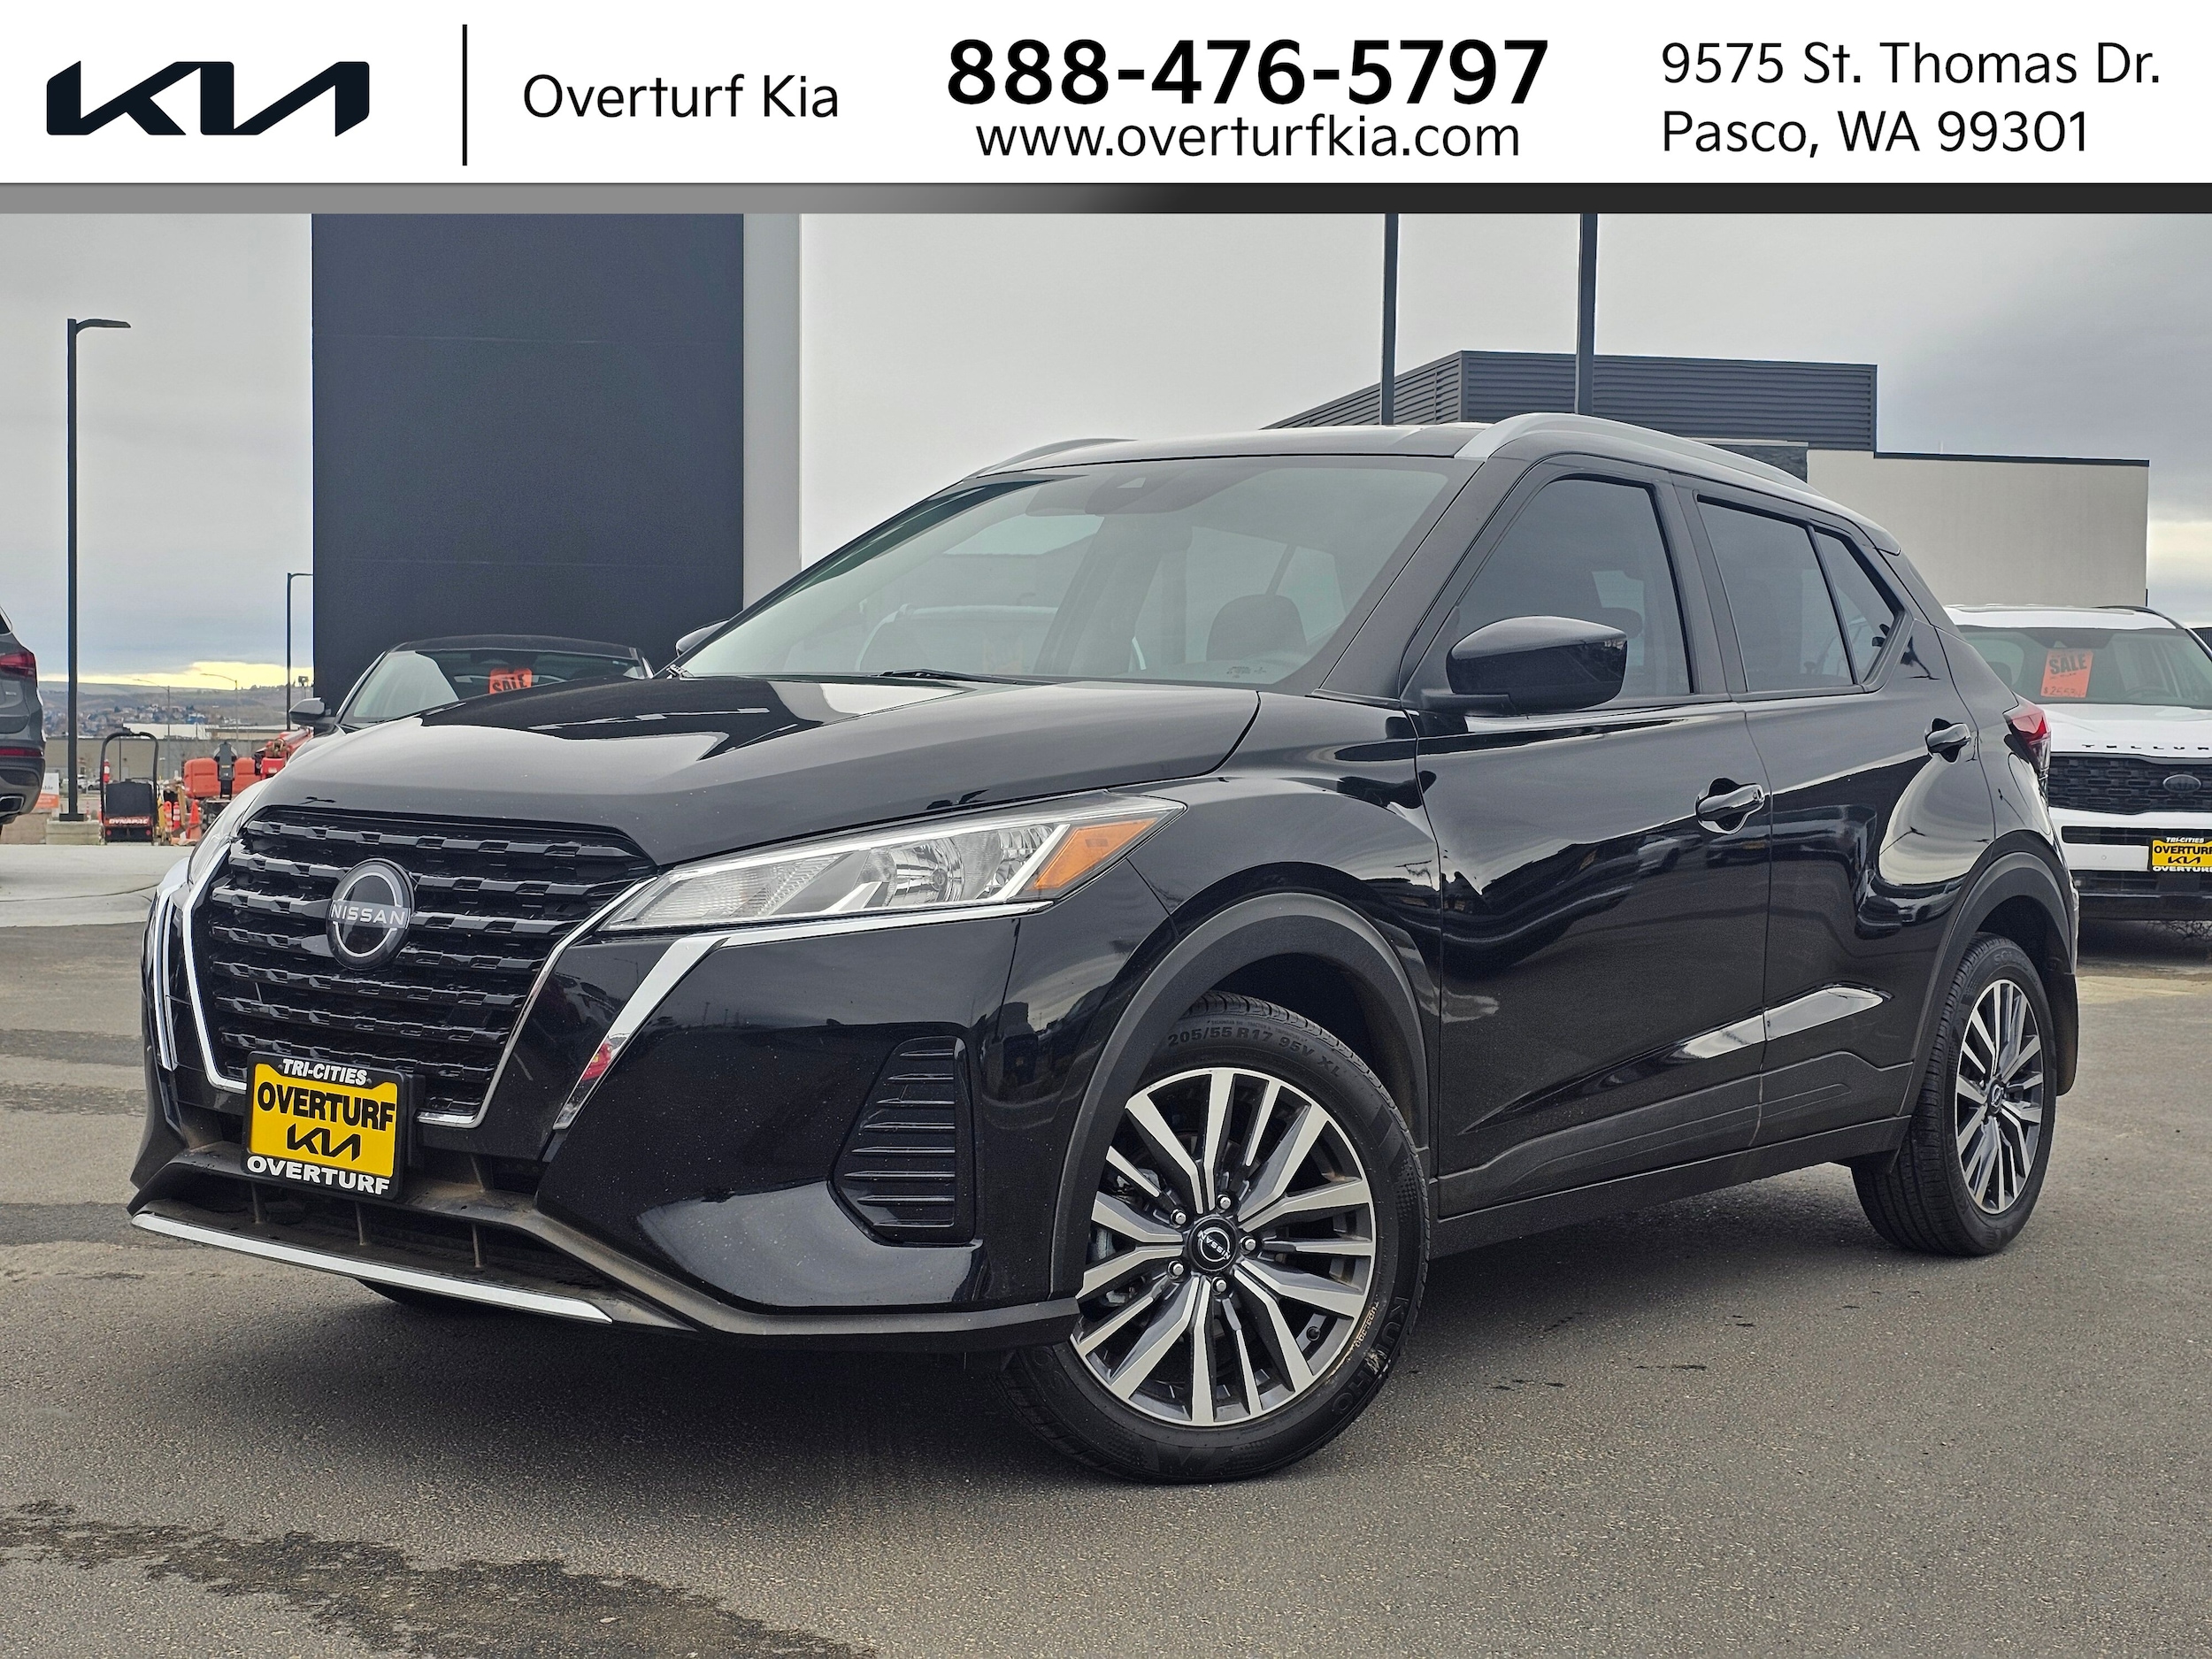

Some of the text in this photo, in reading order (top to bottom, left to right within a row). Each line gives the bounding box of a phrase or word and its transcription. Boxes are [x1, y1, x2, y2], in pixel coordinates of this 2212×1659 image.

[2049, 654, 2087, 675] SALE
[330, 903, 405, 926] NISSAN
[1167, 1026, 1233, 1048] 205/55
[1236, 1026, 1273, 1042] R17
[1278, 1036, 1315, 1057] 95V
[1317, 1055, 1342, 1079] XL
[282, 1058, 368, 1087] TRI-CITIES
[257, 1081, 396, 1132] OVERTURF
[287, 1123, 361, 1162] KIA
[247, 1155, 390, 1194] OVERTURF
[1197, 1230, 1231, 1260] NISSAN
